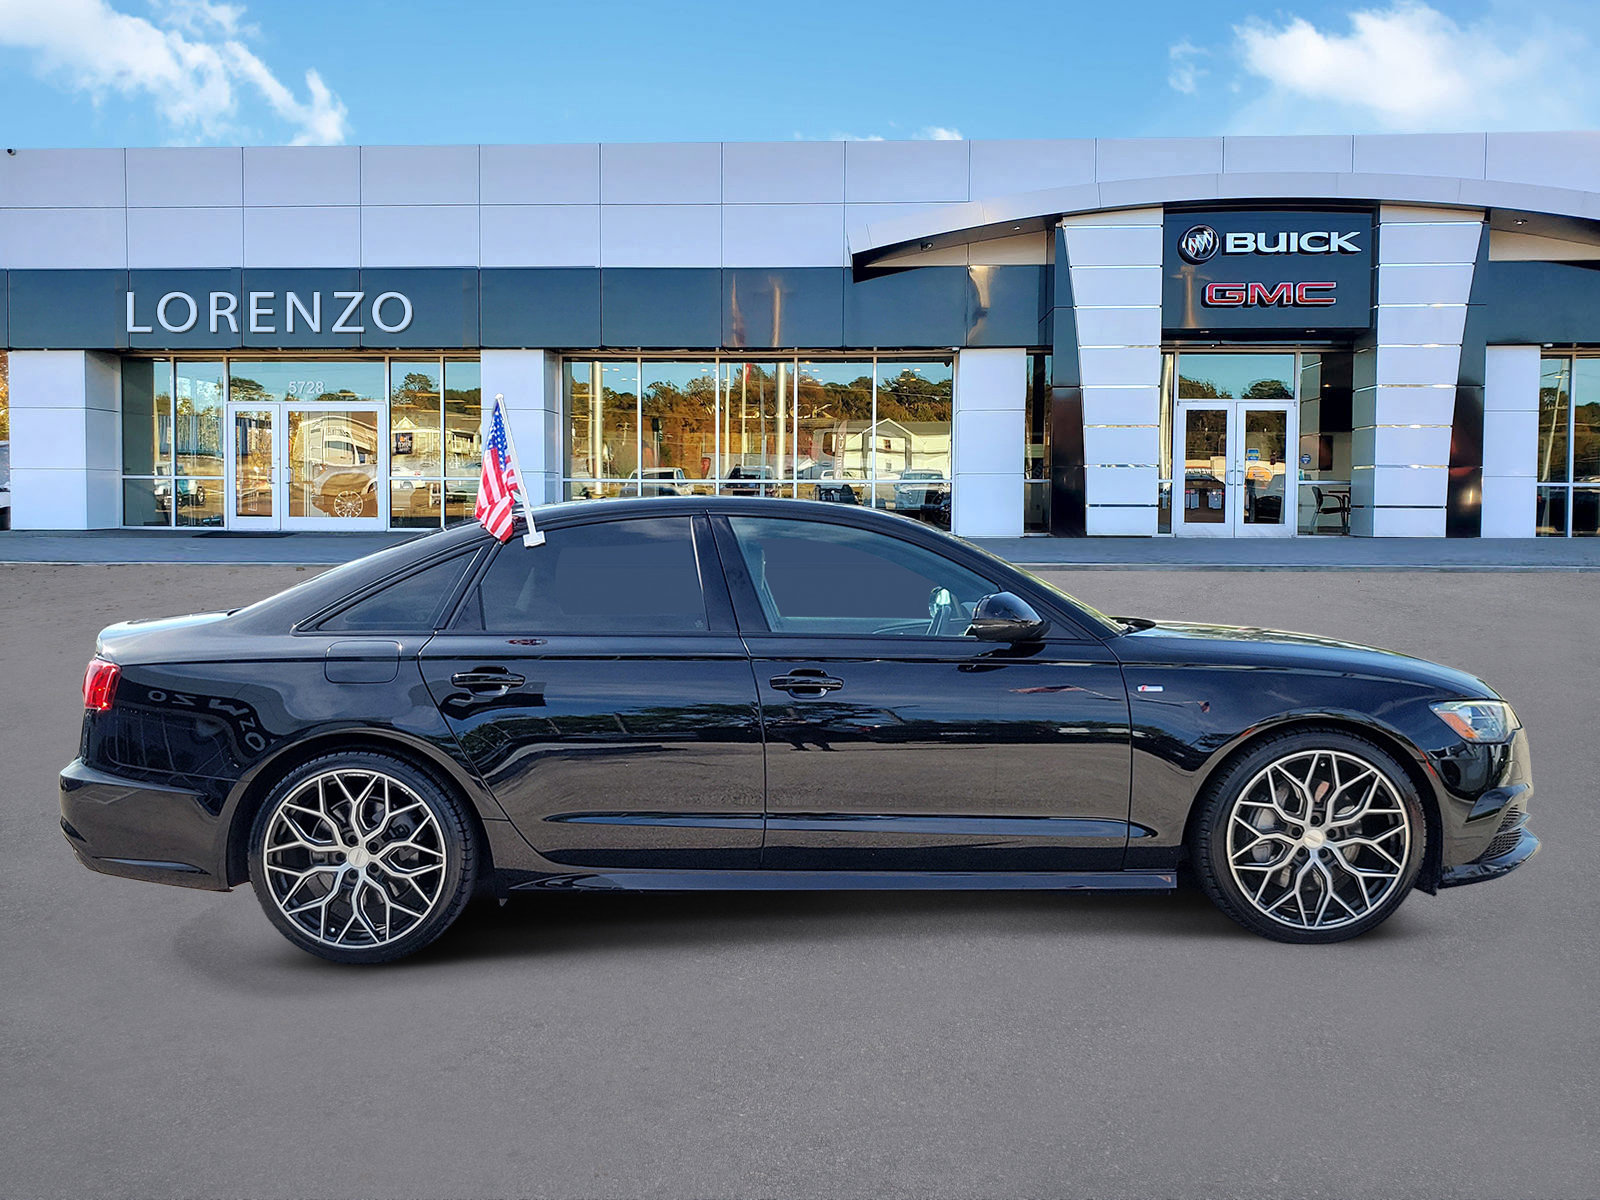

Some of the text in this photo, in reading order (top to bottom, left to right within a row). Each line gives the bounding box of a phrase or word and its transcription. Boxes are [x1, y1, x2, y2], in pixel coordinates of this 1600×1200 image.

[1225, 231, 1362, 253] BUICK
[1205, 281, 1337, 305] GMC
[126, 291, 414, 334] LORENZO
[288, 380, 325, 394] 5728
[738, 403, 833, 419] BUCK
